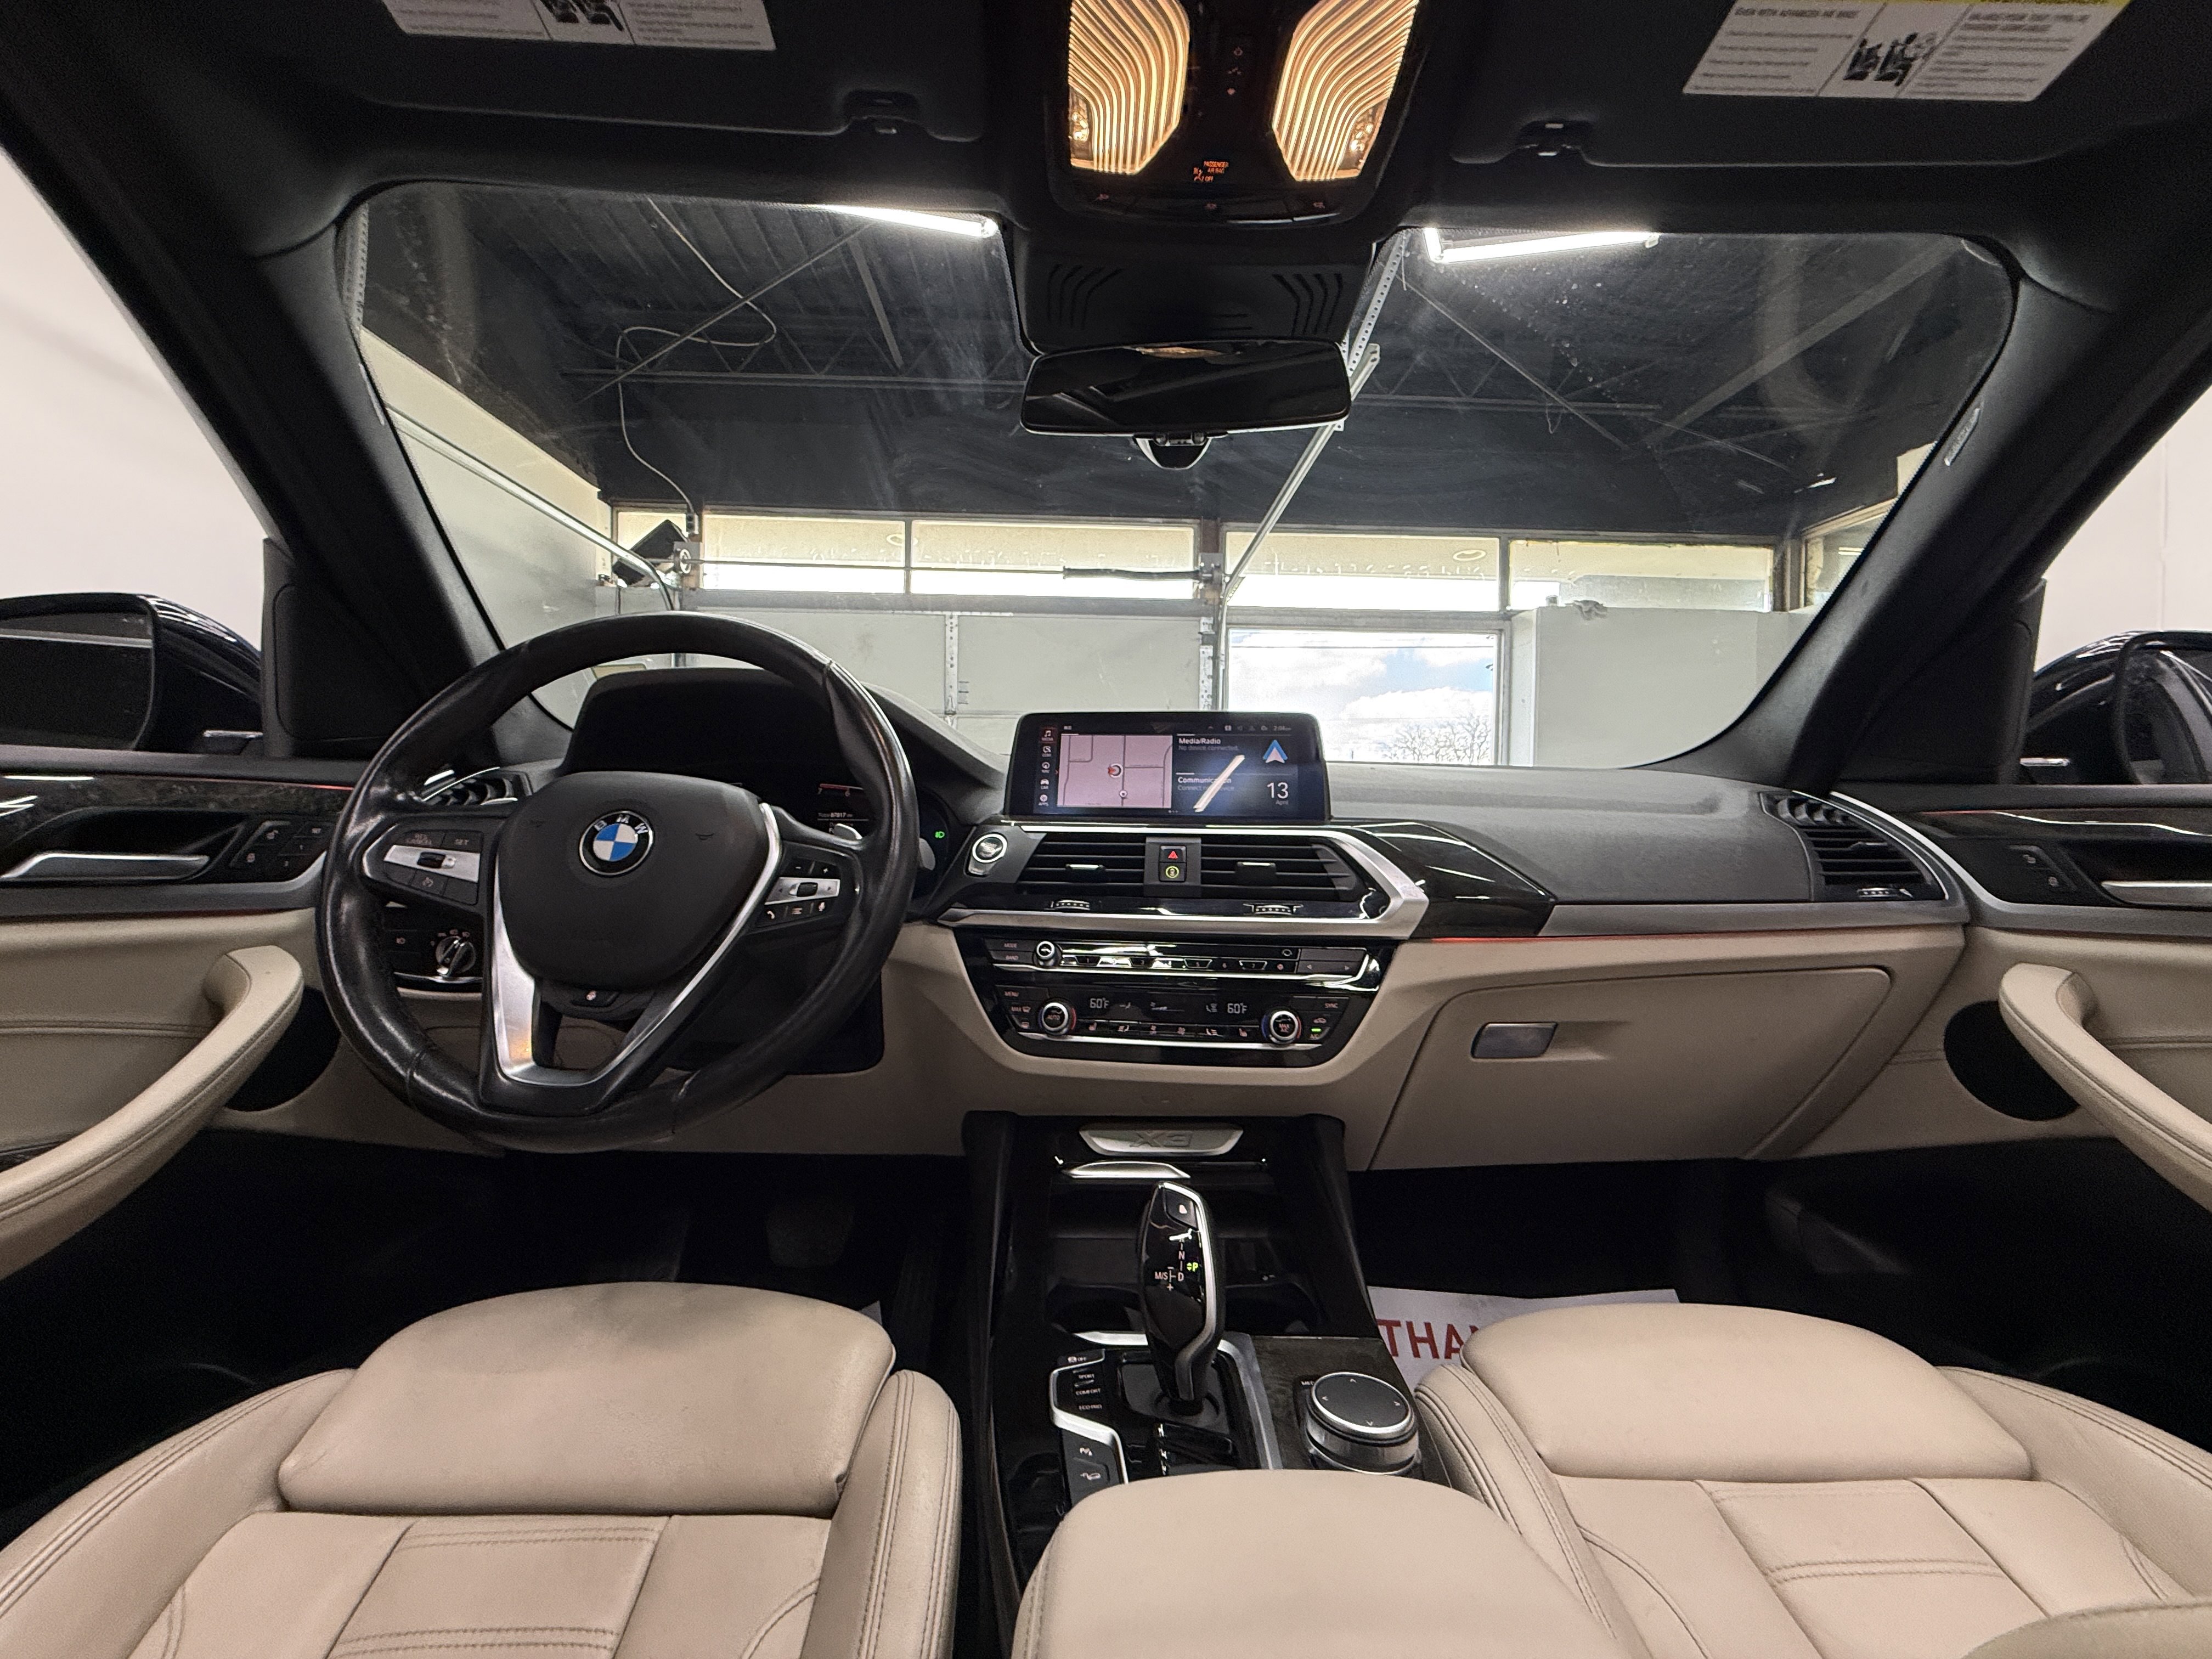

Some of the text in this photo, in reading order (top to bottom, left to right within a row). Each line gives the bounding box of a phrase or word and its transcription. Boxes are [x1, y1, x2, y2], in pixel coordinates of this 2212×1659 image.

[1267, 782, 1289, 799] 13
[594, 814, 648, 834] BMW
[1129, 1130, 1193, 1148] X3
[1178, 1250, 1185, 1260] N
[1192, 1262, 1199, 1272] P
[1154, 1271, 1169, 1281] M/S
[1178, 1272, 1184, 1282] D
[1376, 1319, 1480, 1359] THA
